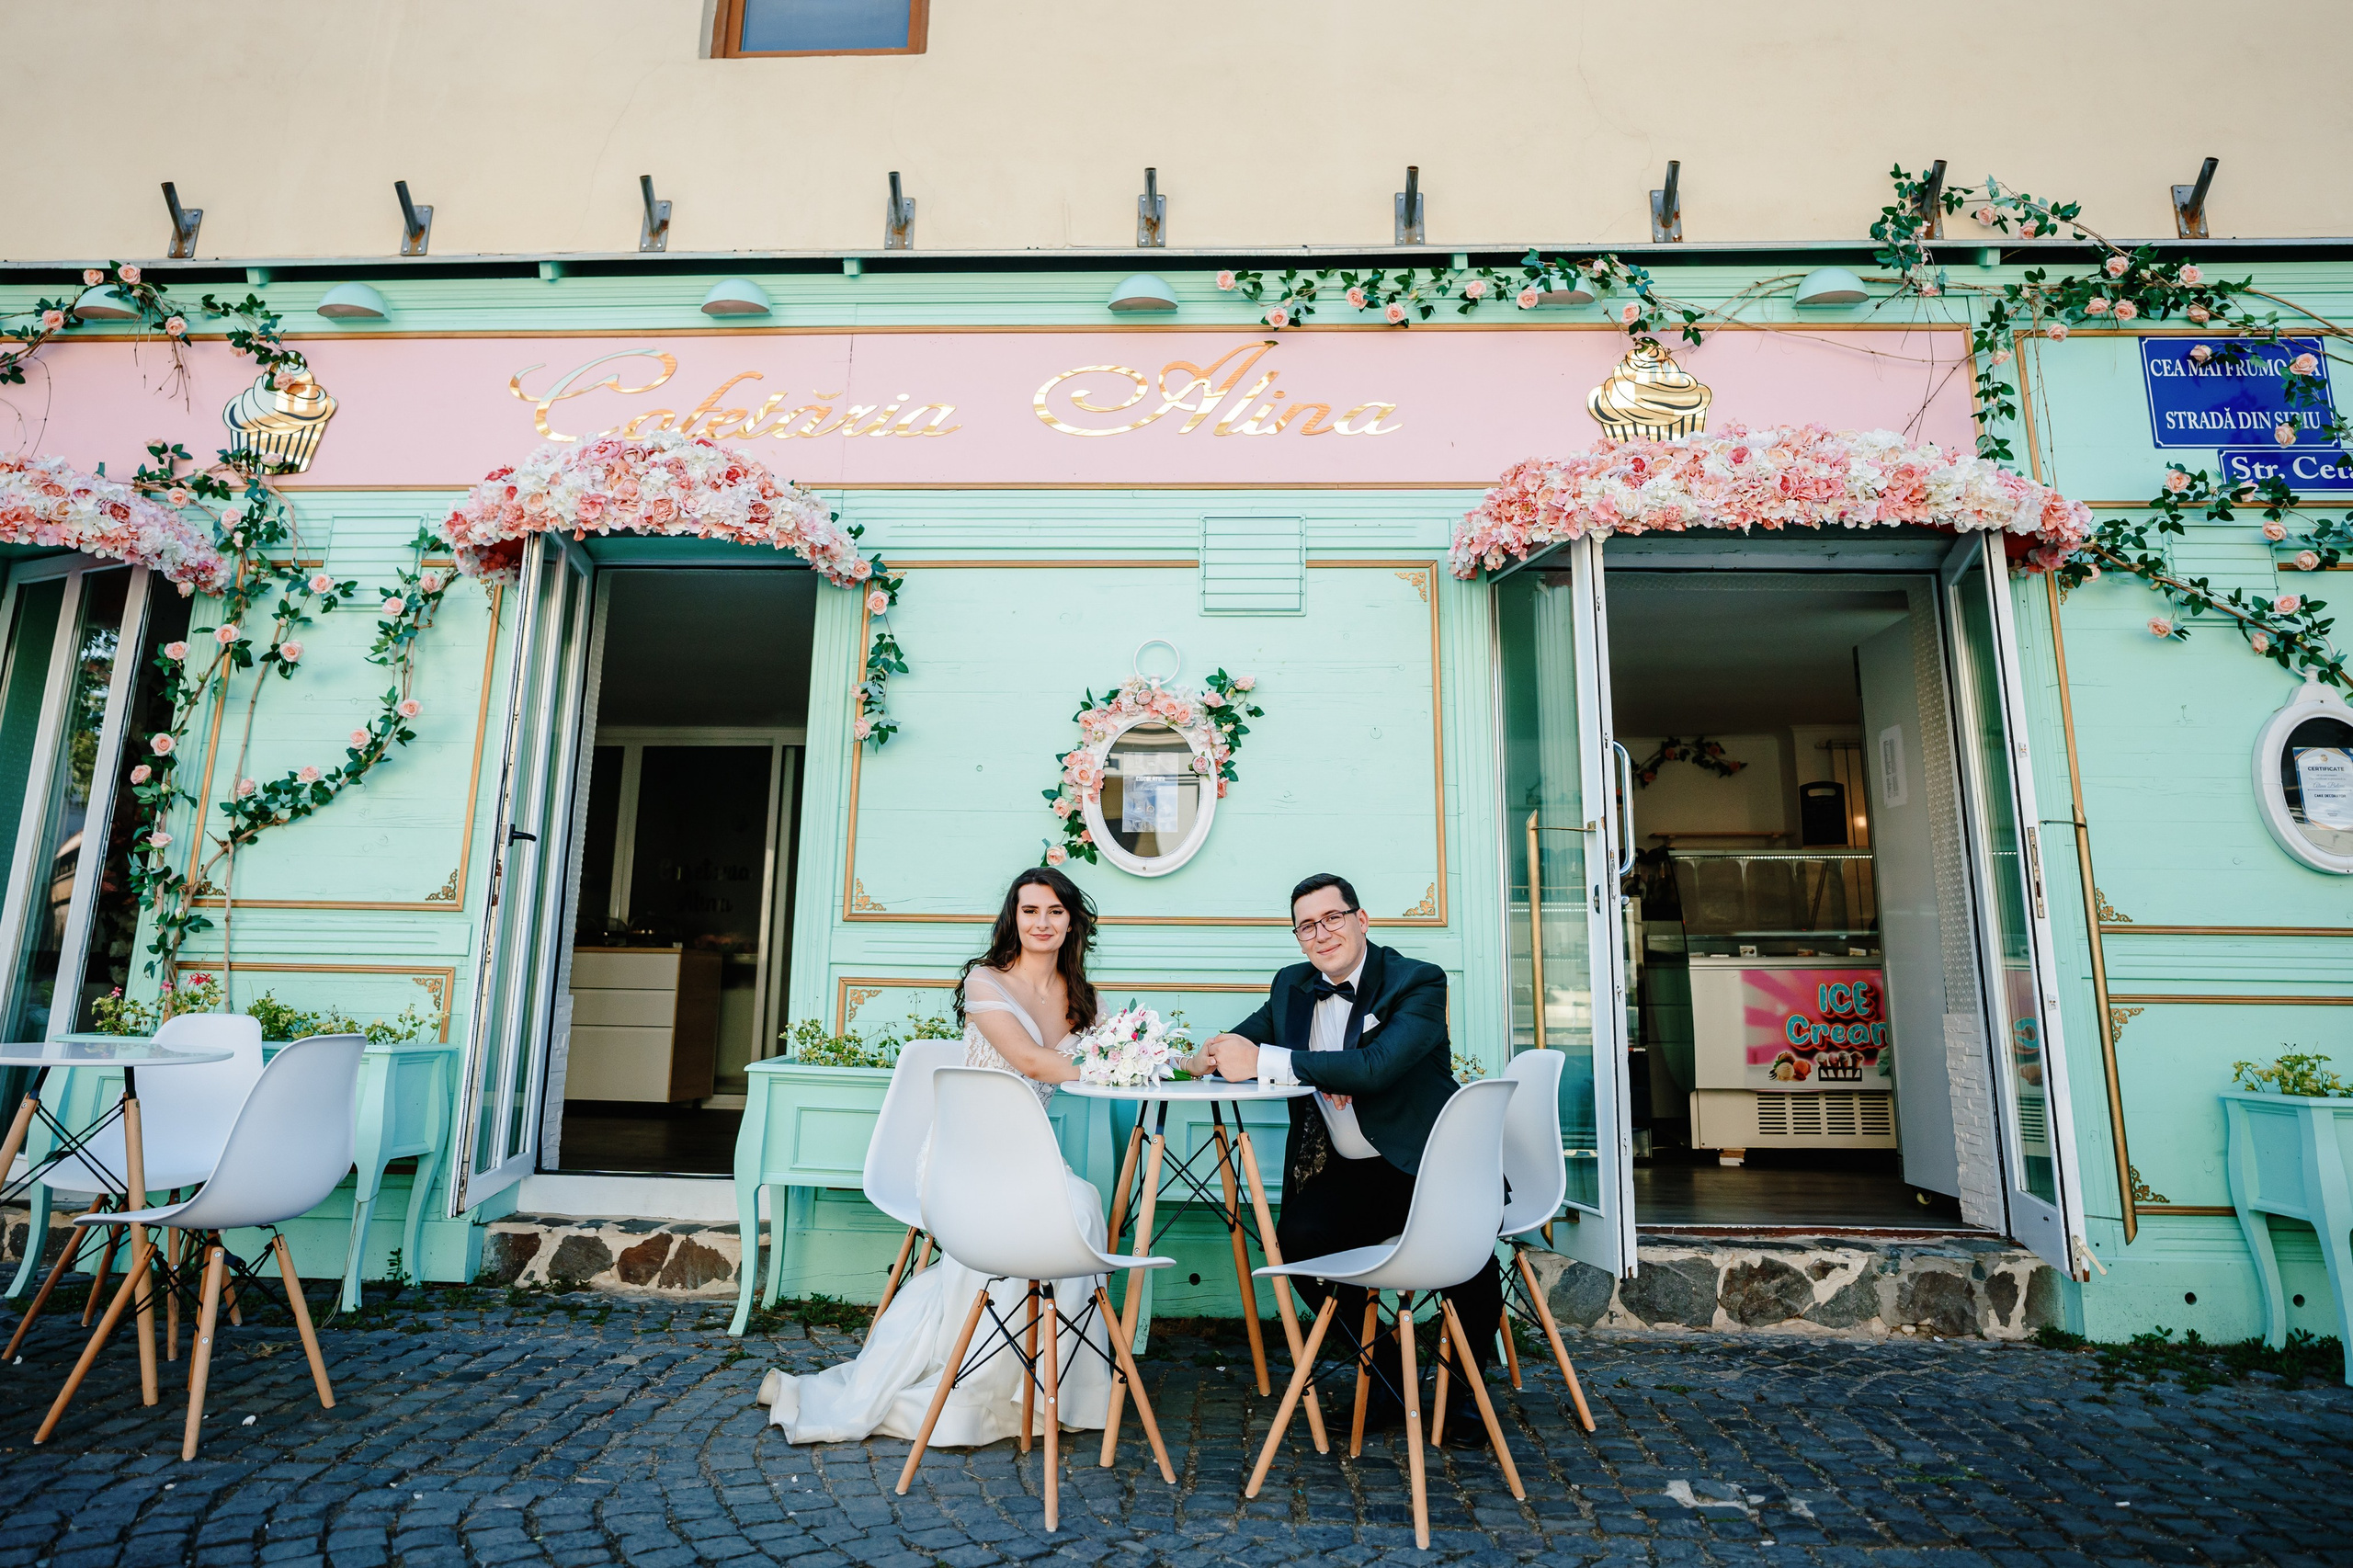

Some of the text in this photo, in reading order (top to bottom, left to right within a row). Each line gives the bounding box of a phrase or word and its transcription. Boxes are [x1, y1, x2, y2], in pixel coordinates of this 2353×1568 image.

[2150, 358, 2322, 377] CEA MAI FRUMO
[508, 340, 1404, 443] Cofetăria Alina
[2165, 407, 2237, 430] STRADĂ
[2236, 411, 2271, 430] DIN
[2231, 456, 2286, 480] Str.
[1818, 981, 1870, 1016] ICE
